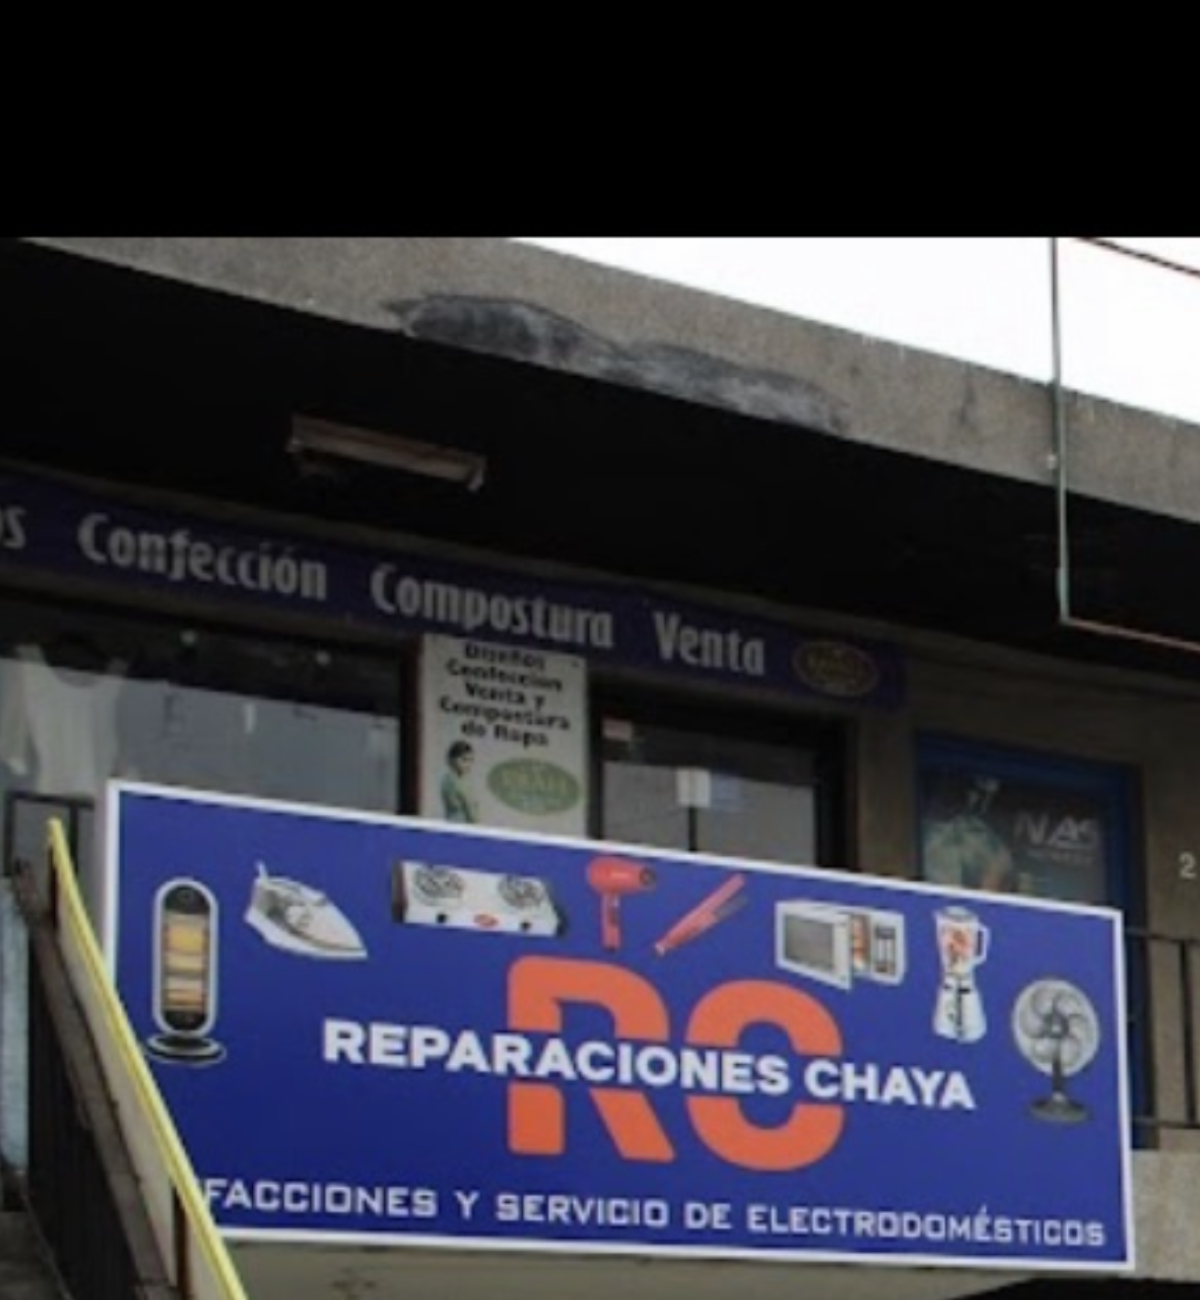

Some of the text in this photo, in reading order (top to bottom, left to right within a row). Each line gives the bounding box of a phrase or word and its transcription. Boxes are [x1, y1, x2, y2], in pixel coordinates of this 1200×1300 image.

[0, 504, 27, 550] s
[76, 511, 328, 599] Confección
[368, 561, 615, 648] Compostura
[654, 611, 766, 677] Venta
[1179, 852, 1197, 879] 2
[323, 1018, 977, 1110] REPARACIONES CHAYA
[202, 1177, 1106, 1248] FACCIONES Y SERVICIO DE ELECTRODOMÉSTICOS
